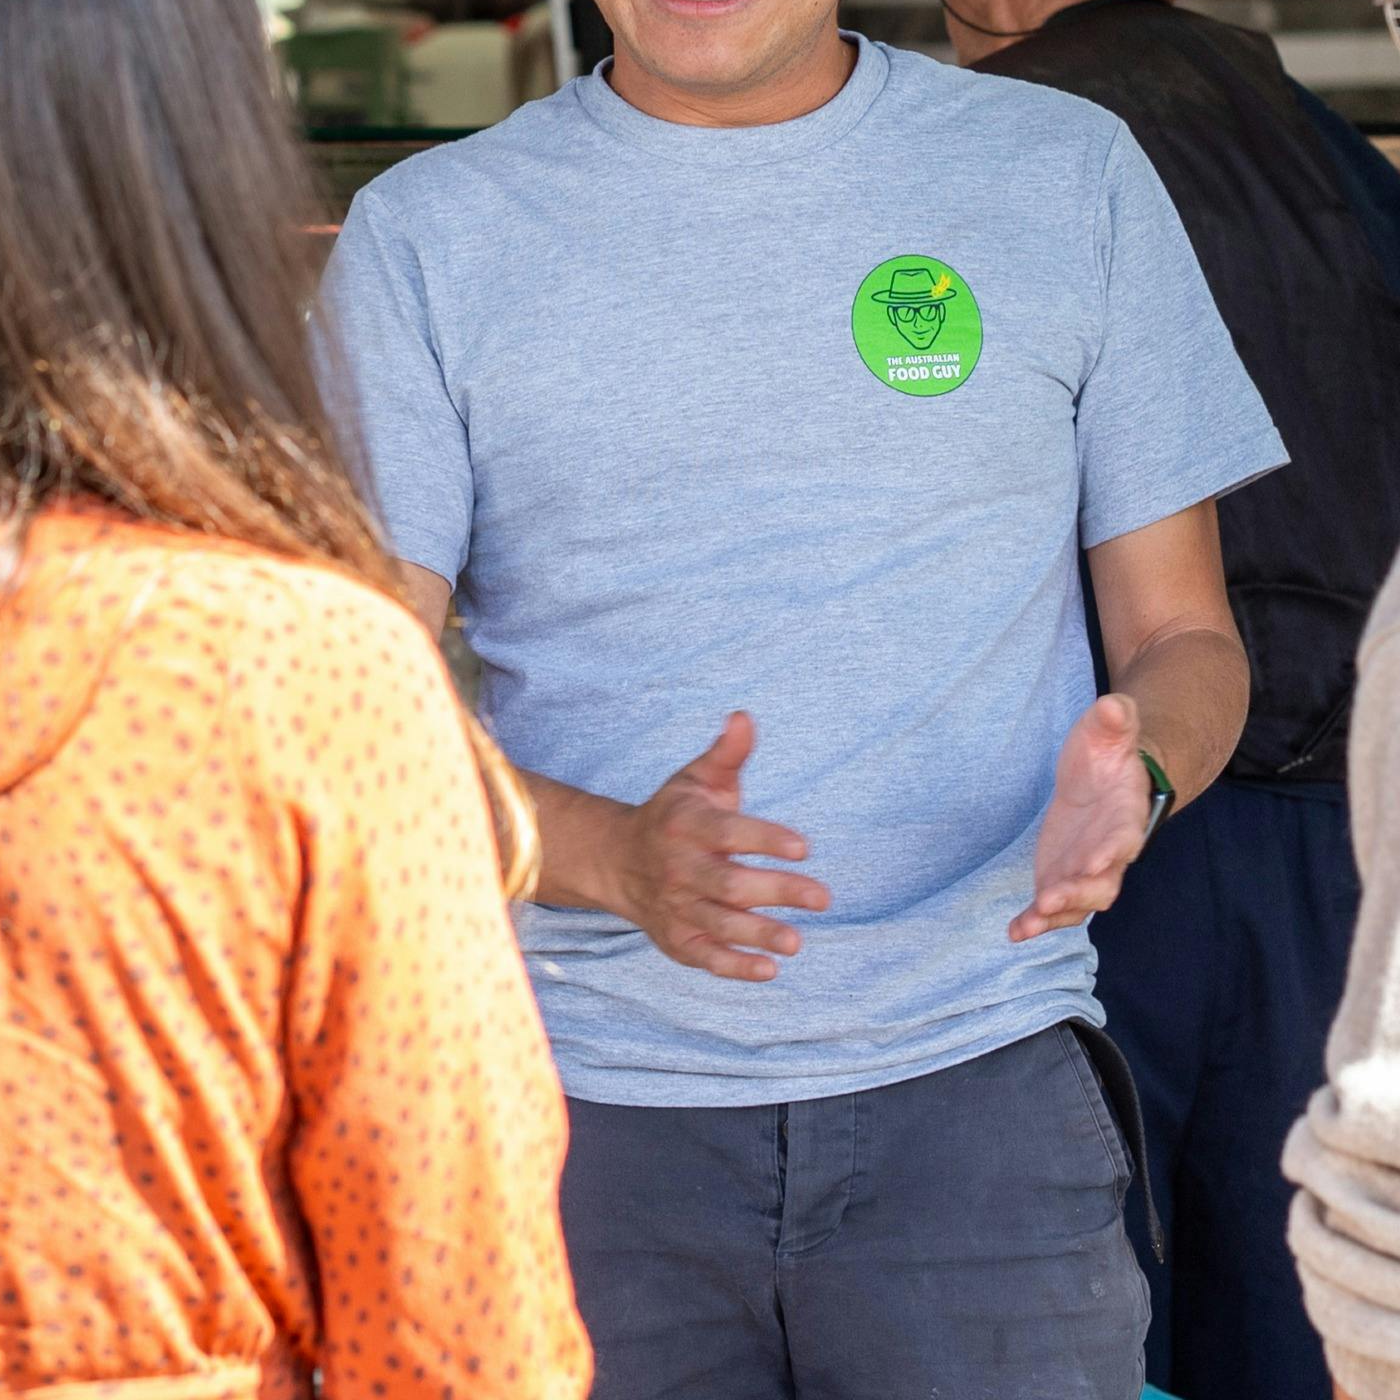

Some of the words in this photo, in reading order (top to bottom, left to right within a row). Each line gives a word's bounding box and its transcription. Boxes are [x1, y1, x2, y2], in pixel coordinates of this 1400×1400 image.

[887, 357, 903, 366] THE
[905, 353, 960, 365] AUSTRALIAN
[888, 366, 930, 382] FOOD
[932, 364, 961, 379] GUY
